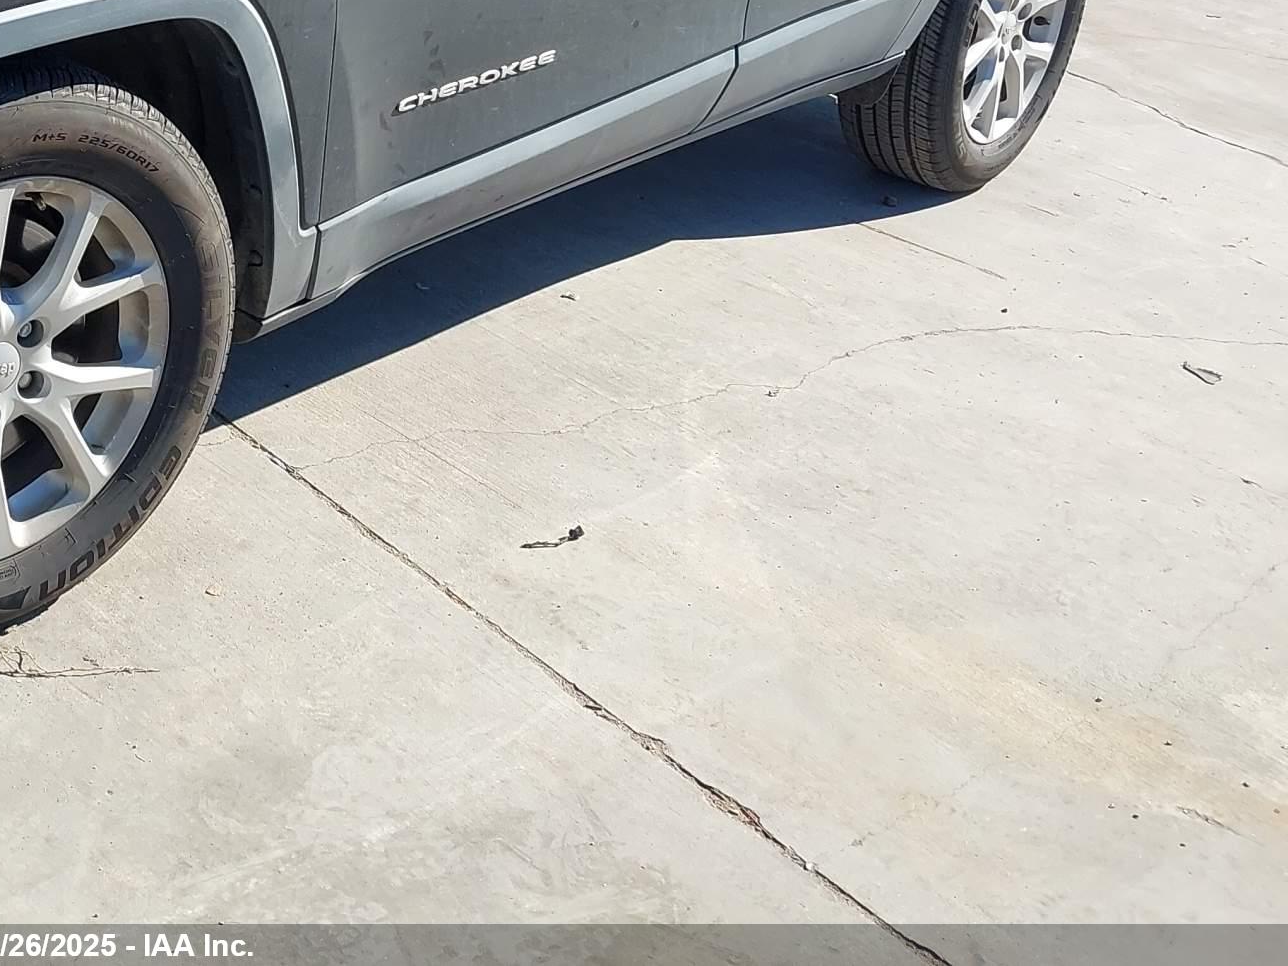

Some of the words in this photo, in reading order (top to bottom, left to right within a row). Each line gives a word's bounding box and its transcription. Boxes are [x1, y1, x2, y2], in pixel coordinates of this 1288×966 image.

[397, 49, 557, 114] CHEROKEE
[32, 131, 67, 143] M+S
[78, 134, 161, 173] 225/60R17
[39, 445, 182, 601] EDITION
